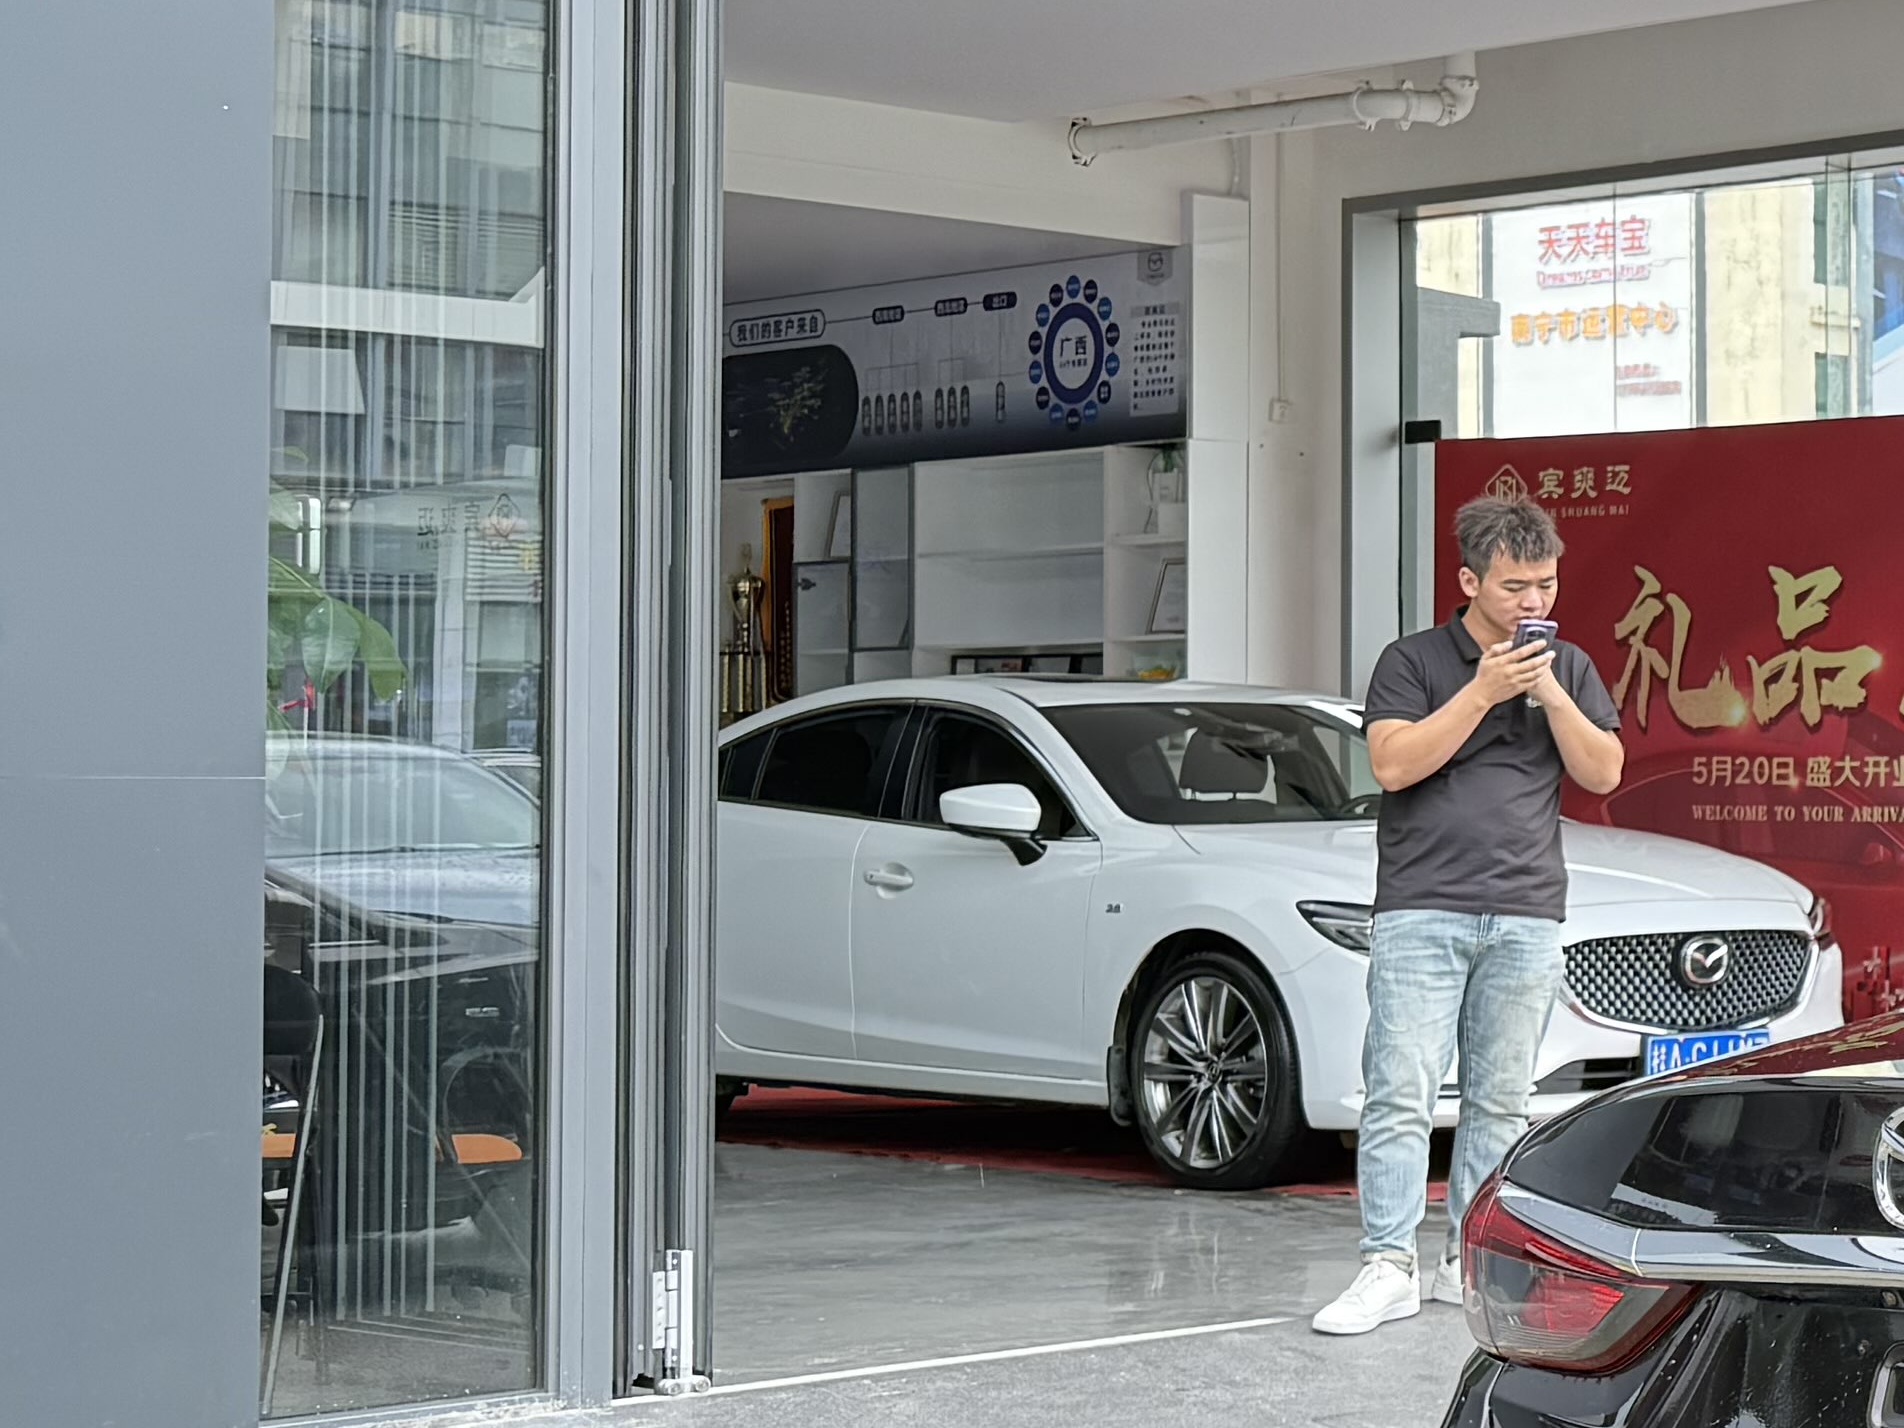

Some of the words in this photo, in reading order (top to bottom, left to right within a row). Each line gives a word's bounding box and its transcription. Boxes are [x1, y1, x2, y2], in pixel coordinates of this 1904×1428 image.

[1538, 215, 1651, 264] 天天车宝
[737, 315, 819, 343] 我们的客户来自
[1059, 335, 1088, 358] 广西
[1538, 464, 1633, 500] 宾爽迈
[1692, 755, 1798, 787] 5月20日
[1692, 804, 1768, 822] WELCOME
[1774, 805, 1796, 822] TO
[1803, 805, 1845, 823] YOUR
